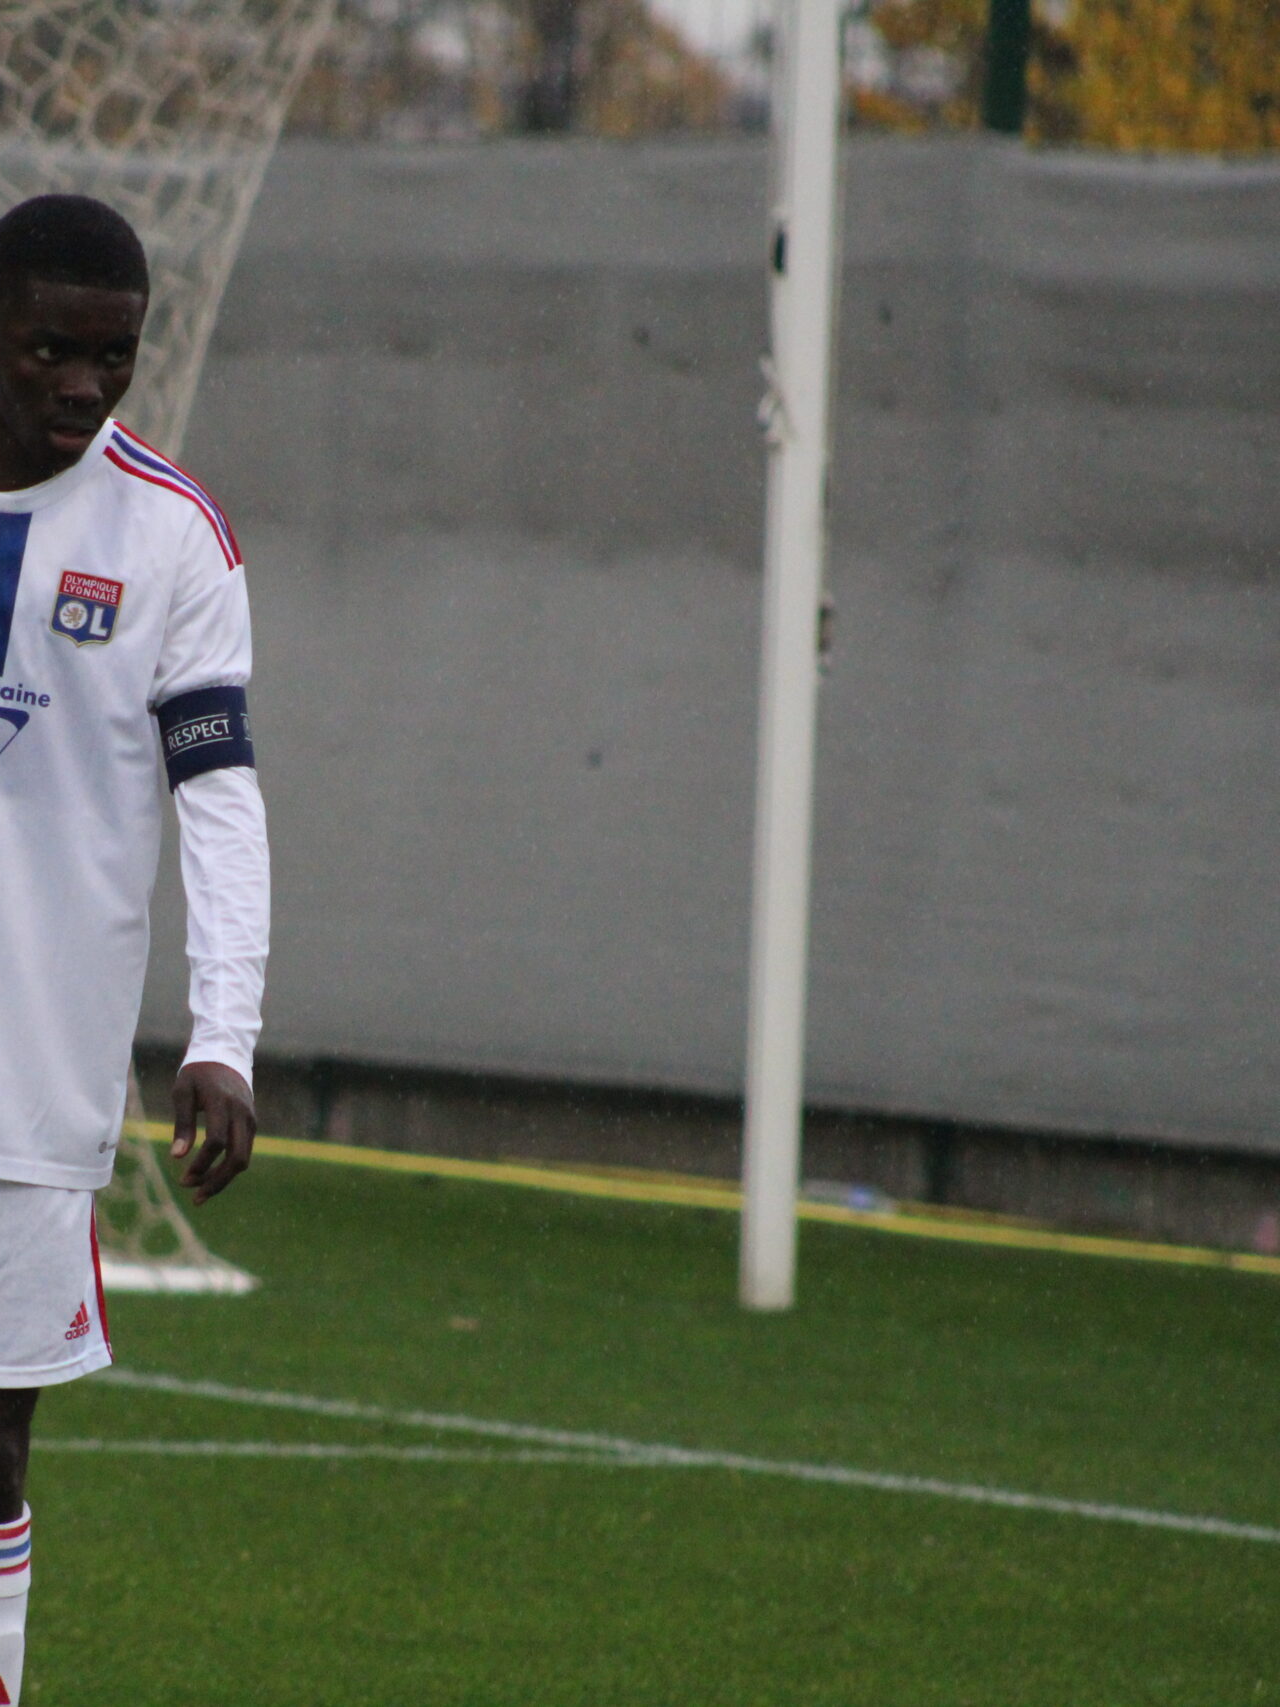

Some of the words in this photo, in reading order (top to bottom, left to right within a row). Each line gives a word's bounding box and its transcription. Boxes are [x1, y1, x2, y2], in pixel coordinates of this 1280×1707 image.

[63, 583, 118, 603] LYONNAIS
[65, 574, 119, 595] OLYMPIQUE
[167, 719, 229, 751] RESPECT
